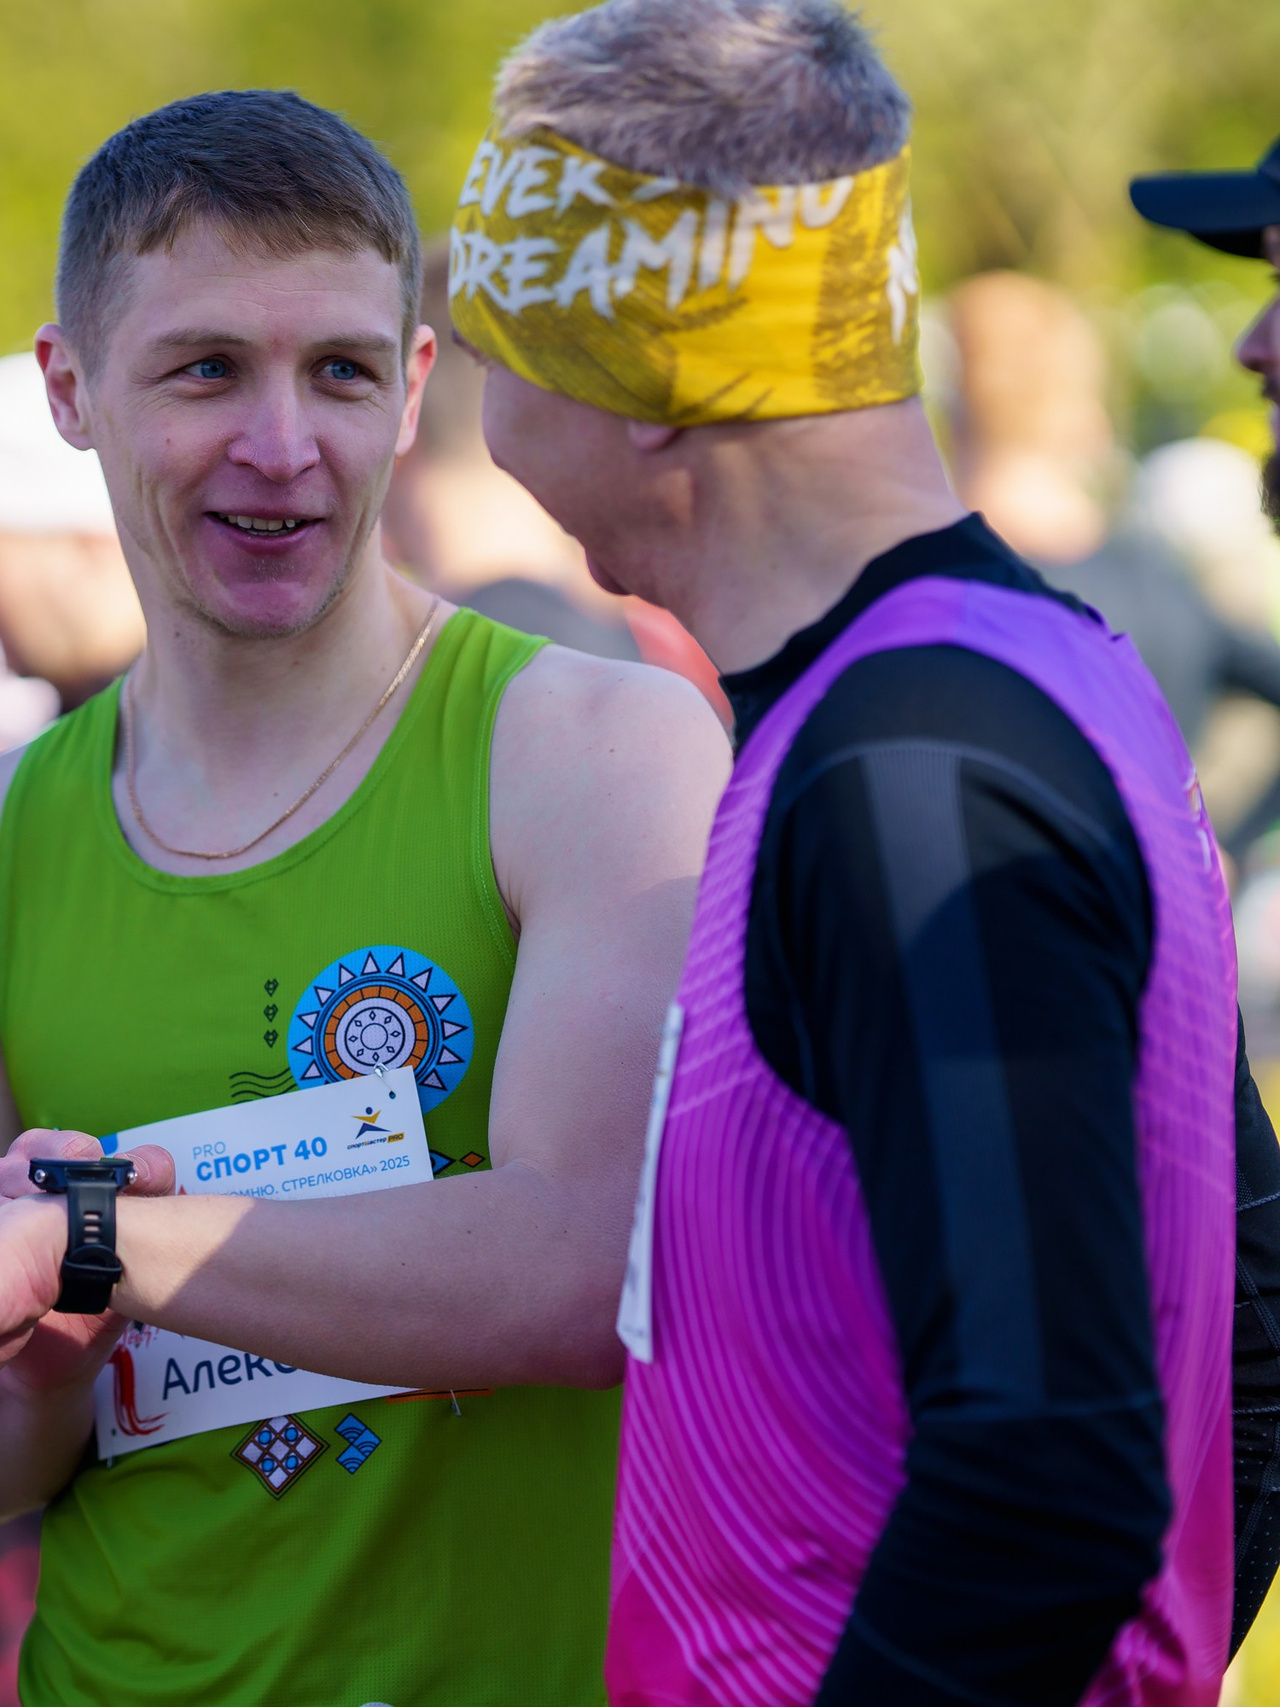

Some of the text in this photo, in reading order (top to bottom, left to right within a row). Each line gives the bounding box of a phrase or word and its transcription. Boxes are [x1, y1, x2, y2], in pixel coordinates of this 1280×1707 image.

[193, 1141, 226, 1159] PRO
[196, 1136, 328, 1181] СПОРТ 40
[281, 1164, 377, 1192] СТРЕЛКОВКА»
[380, 1155, 410, 1172] 2025
